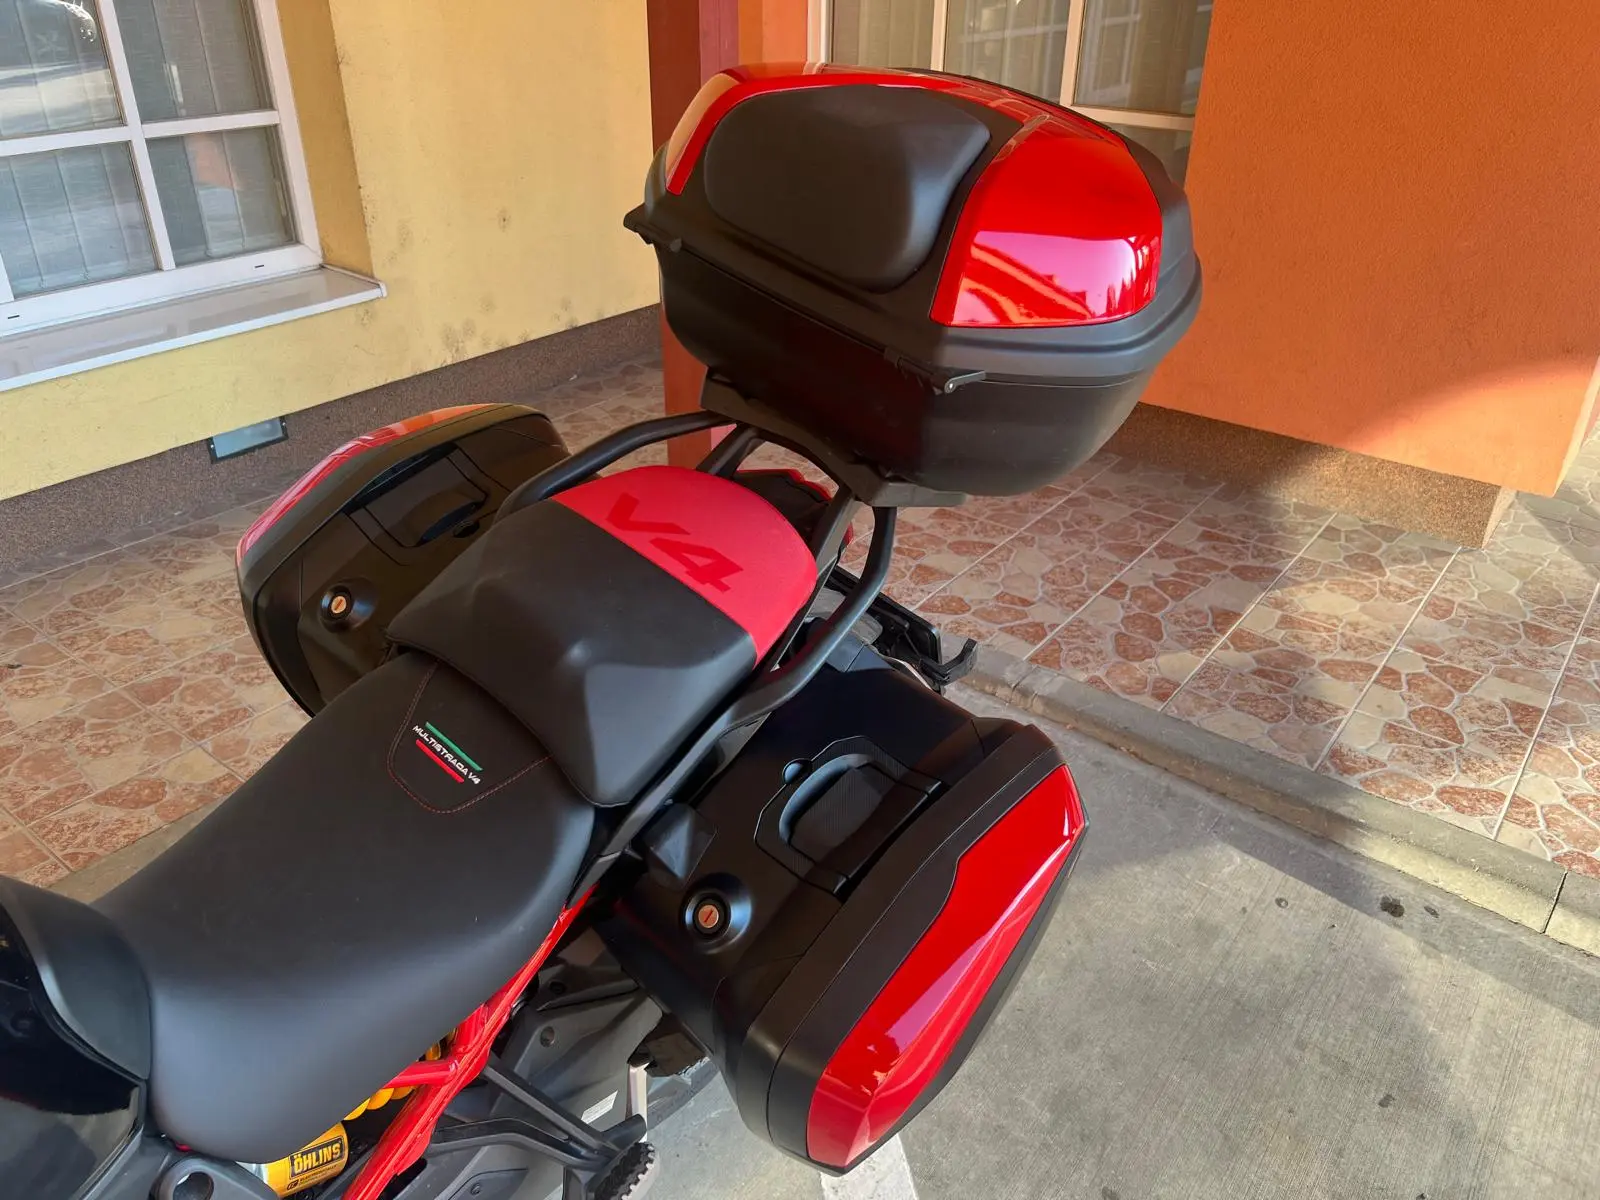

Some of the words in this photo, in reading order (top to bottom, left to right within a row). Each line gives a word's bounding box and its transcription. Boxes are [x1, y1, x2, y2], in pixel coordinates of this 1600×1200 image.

[605, 492, 743, 593] V4
[412, 725, 469, 776] MULTISTRADA
[468, 772, 481, 785] V4
[293, 1142, 341, 1174] ÖHLINS
